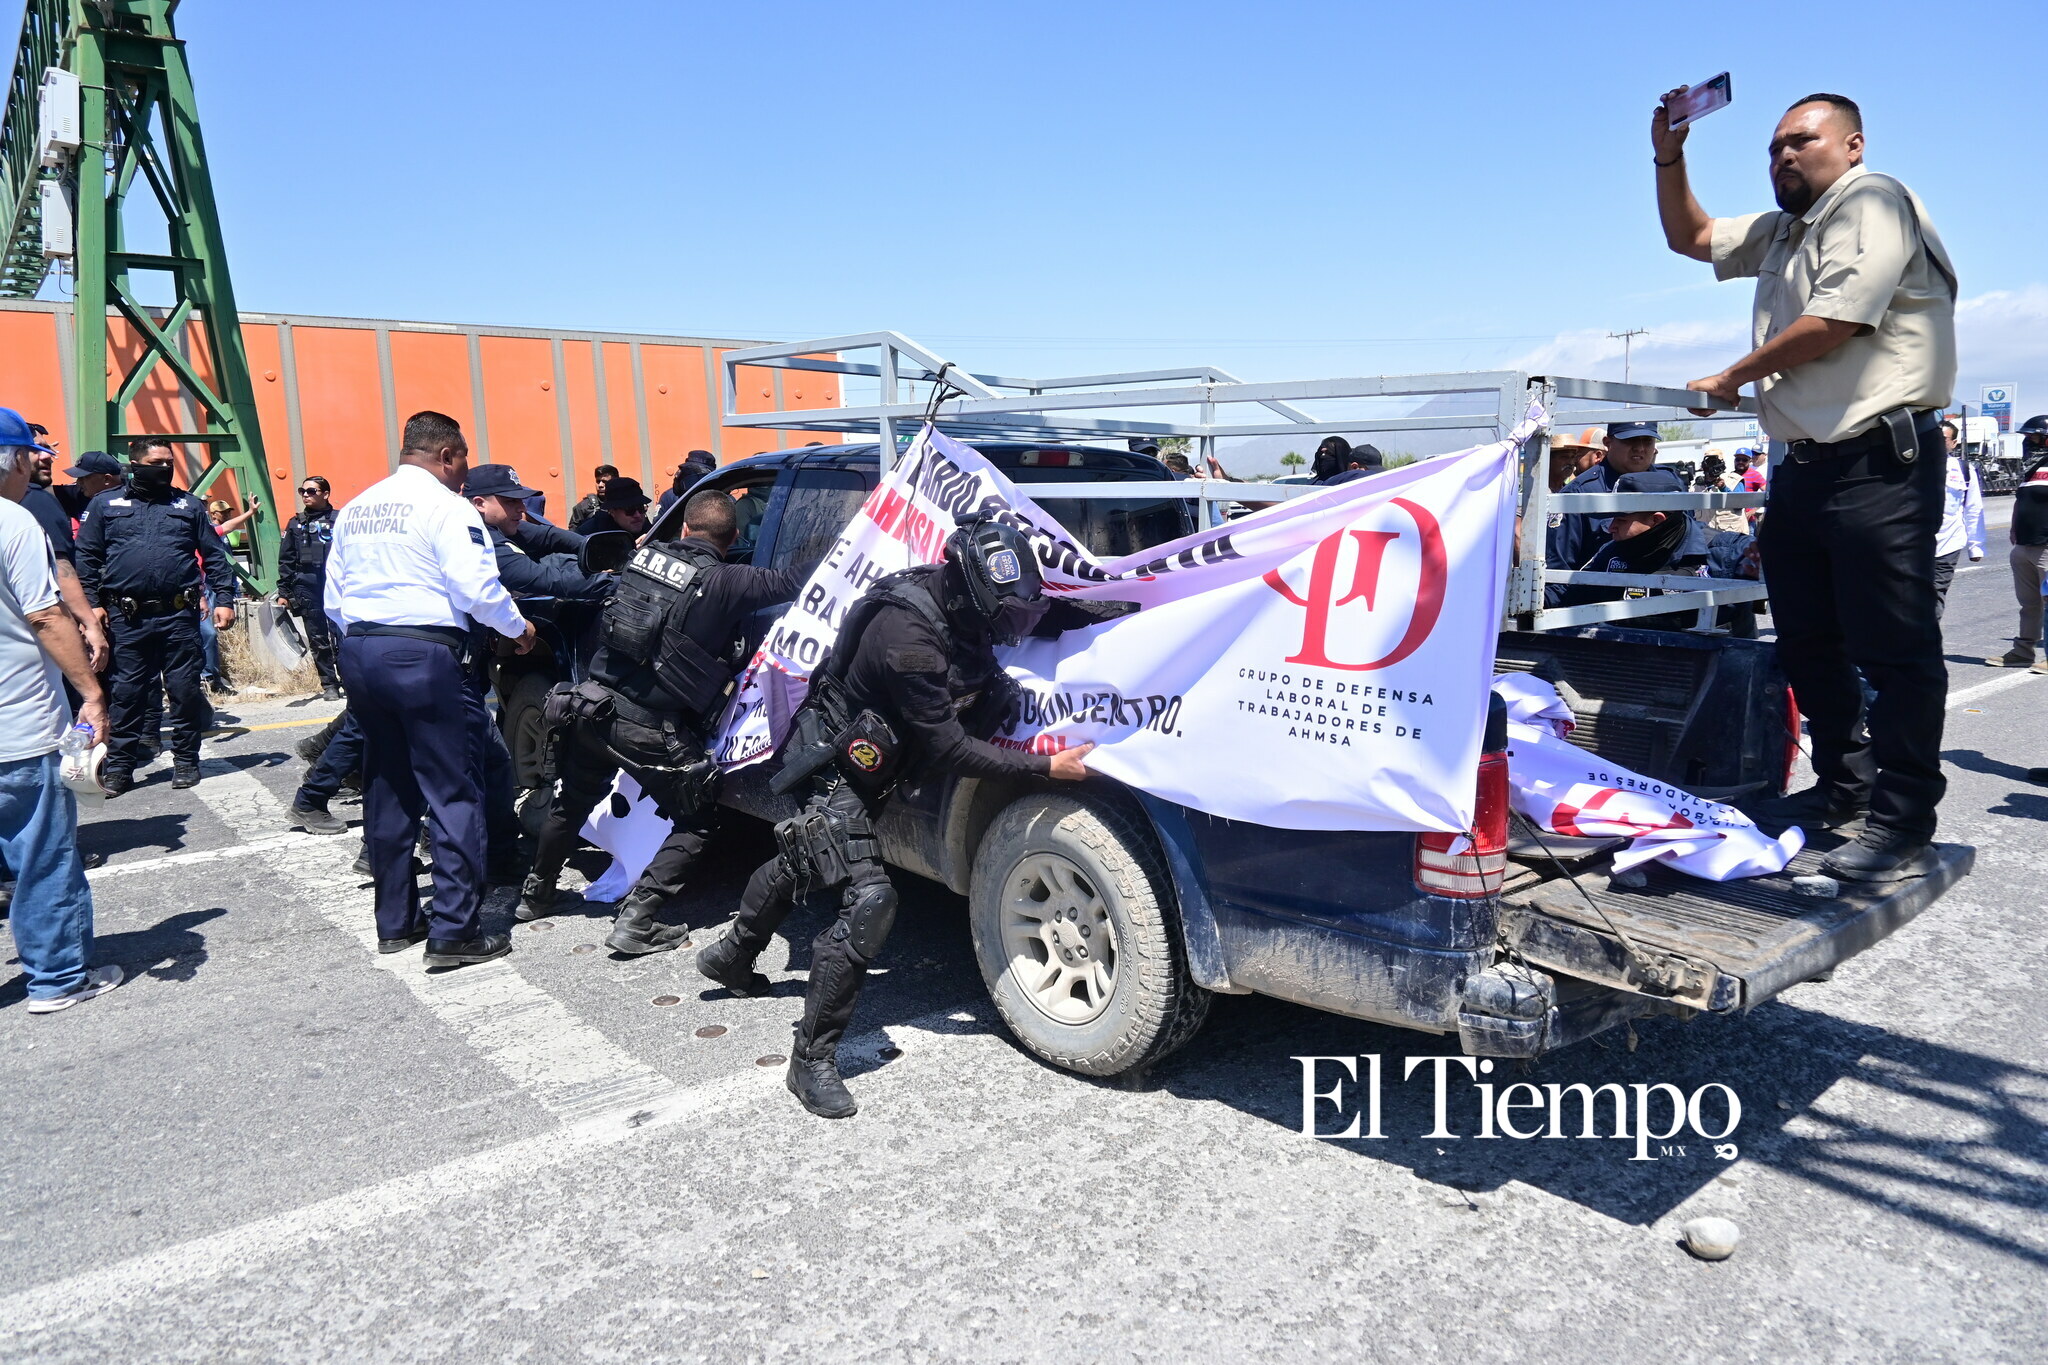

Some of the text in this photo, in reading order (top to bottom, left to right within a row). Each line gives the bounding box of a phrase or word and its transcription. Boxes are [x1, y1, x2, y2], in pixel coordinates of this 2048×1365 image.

[346, 503, 413, 520] TRANSITO
[343, 518, 408, 537] MUNICIPAL
[633, 548, 687, 585] G.R.C.
[1239, 667, 1434, 706] GRUPO DE DEFENSA
[1266, 689, 1387, 717] LABORAL DE
[1238, 700, 1422, 740] TRABAJADORES DE
[1288, 727, 1351, 747] AHMSA
[1587, 772, 1609, 782] DE
